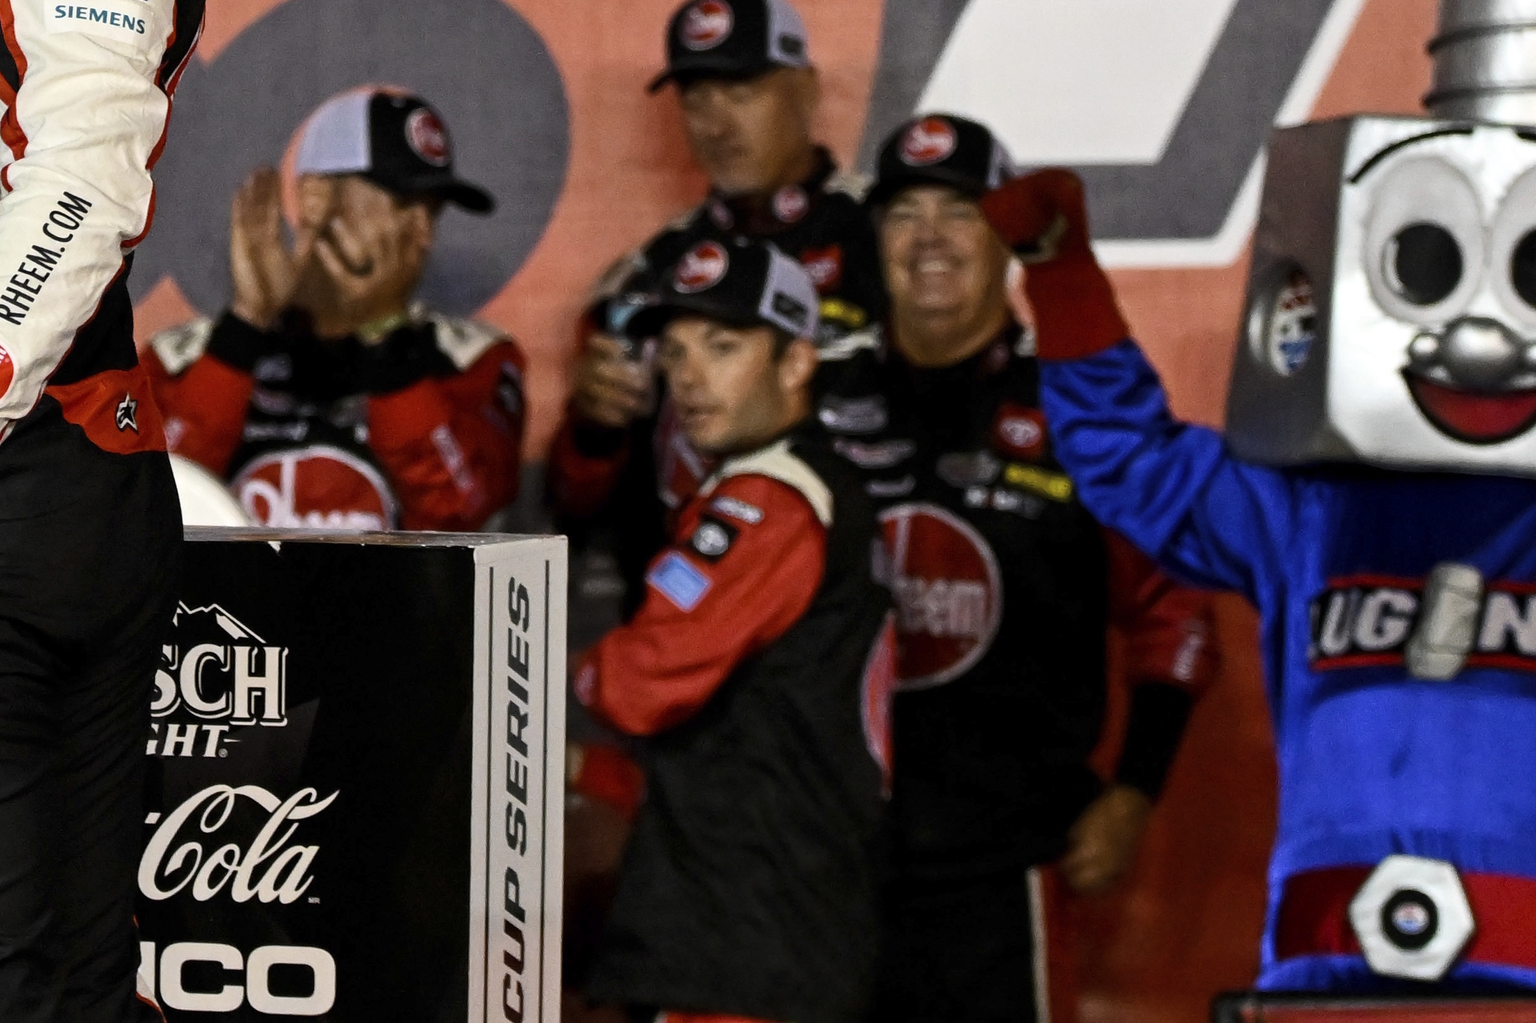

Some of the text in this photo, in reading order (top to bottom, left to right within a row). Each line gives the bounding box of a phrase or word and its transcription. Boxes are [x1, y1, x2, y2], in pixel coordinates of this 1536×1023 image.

[55, 5, 146, 34] SIEMENS
[149, 643, 290, 727] SCH
[502, 576, 531, 1023] CUP SERIES
[139, 941, 336, 1016] ICO
